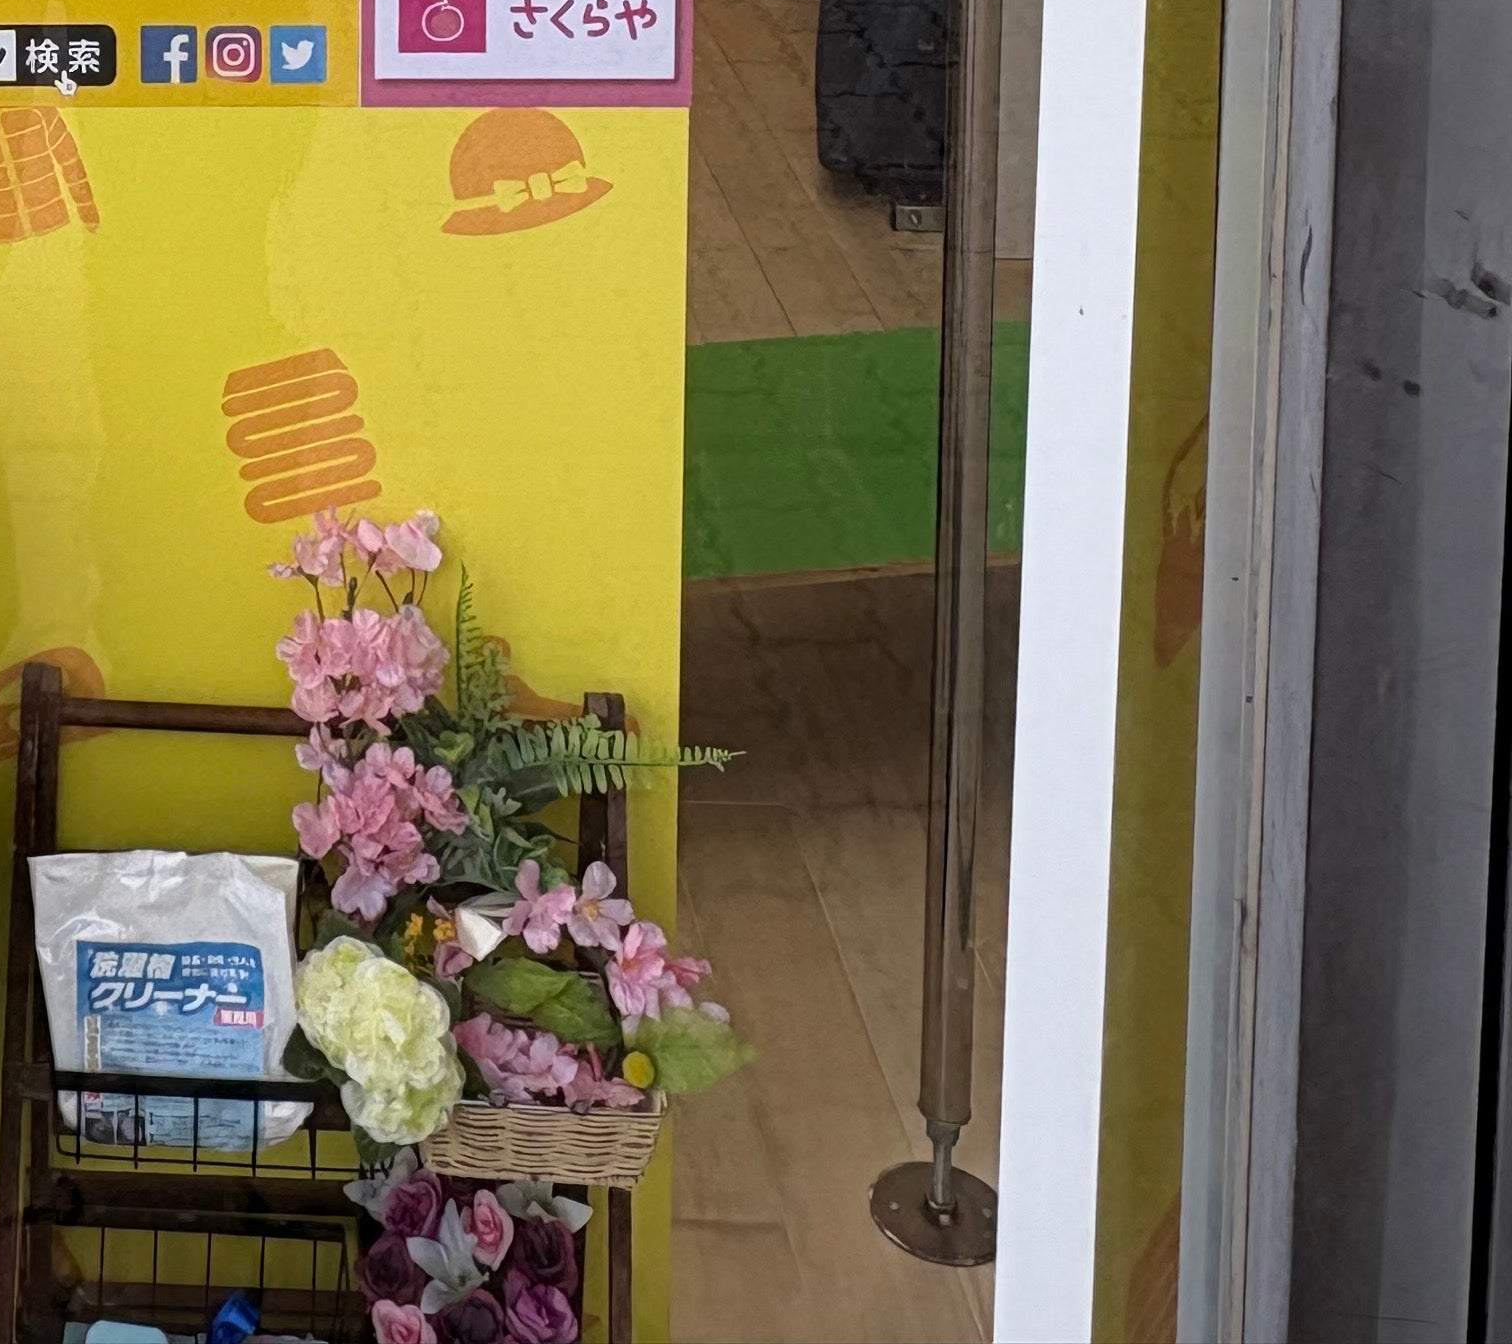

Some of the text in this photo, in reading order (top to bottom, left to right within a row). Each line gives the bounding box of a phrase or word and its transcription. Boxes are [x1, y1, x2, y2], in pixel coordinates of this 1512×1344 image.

[25, 39, 102, 75] 検索
[91, 981, 248, 1012] クリーナー
